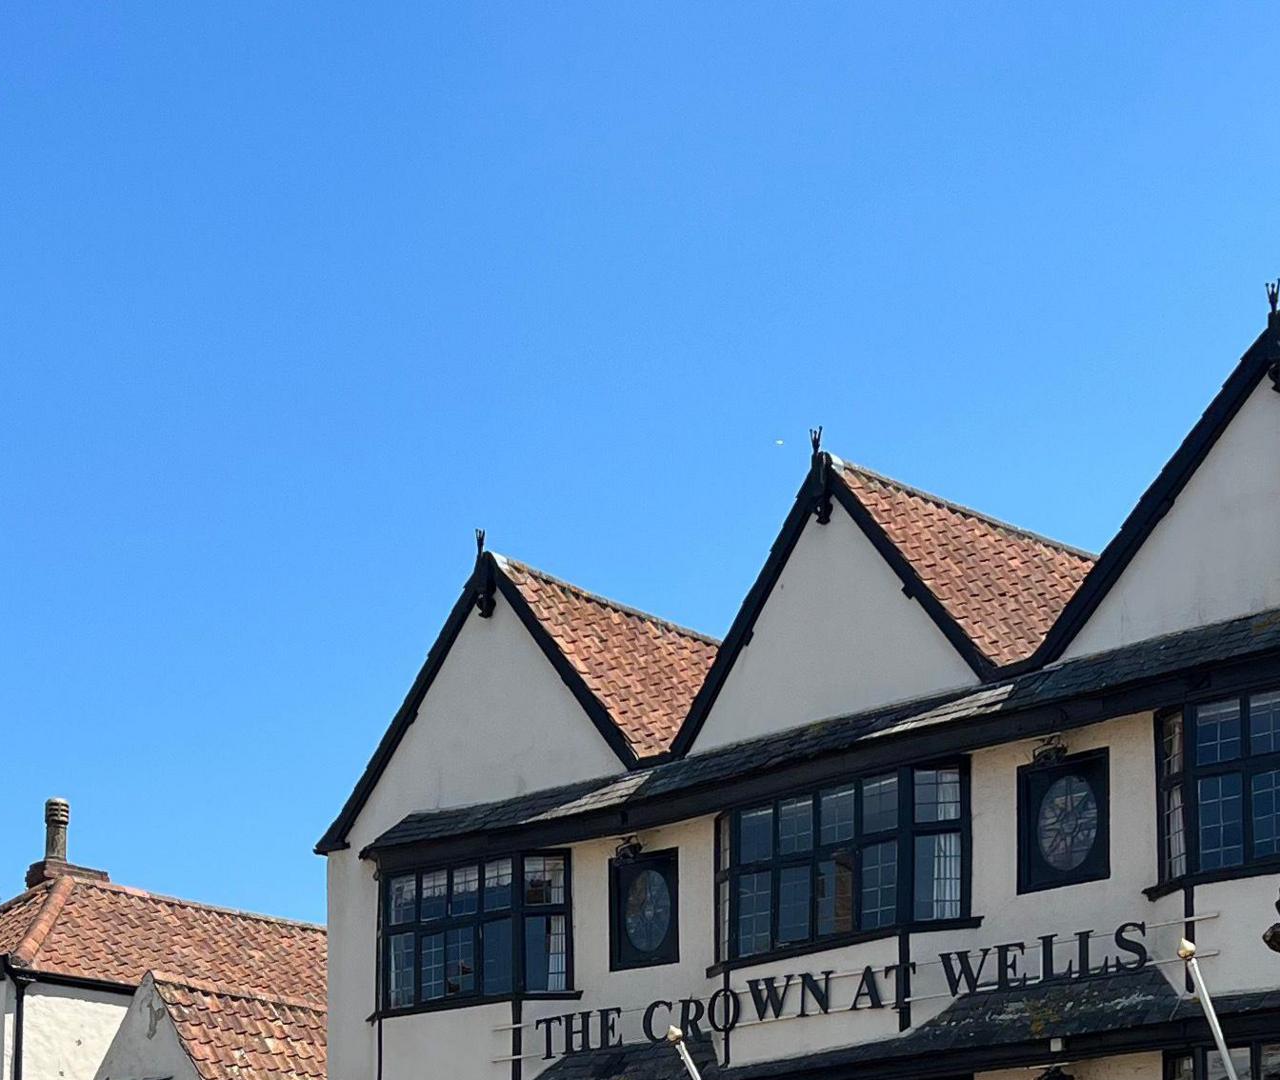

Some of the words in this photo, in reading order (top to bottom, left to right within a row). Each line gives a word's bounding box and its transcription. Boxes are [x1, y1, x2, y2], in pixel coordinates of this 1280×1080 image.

[535, 1007, 622, 1060] THE
[642, 970, 836, 1043] CROWN
[849, 962, 916, 1010] AT
[938, 921, 1148, 998] WELLS
